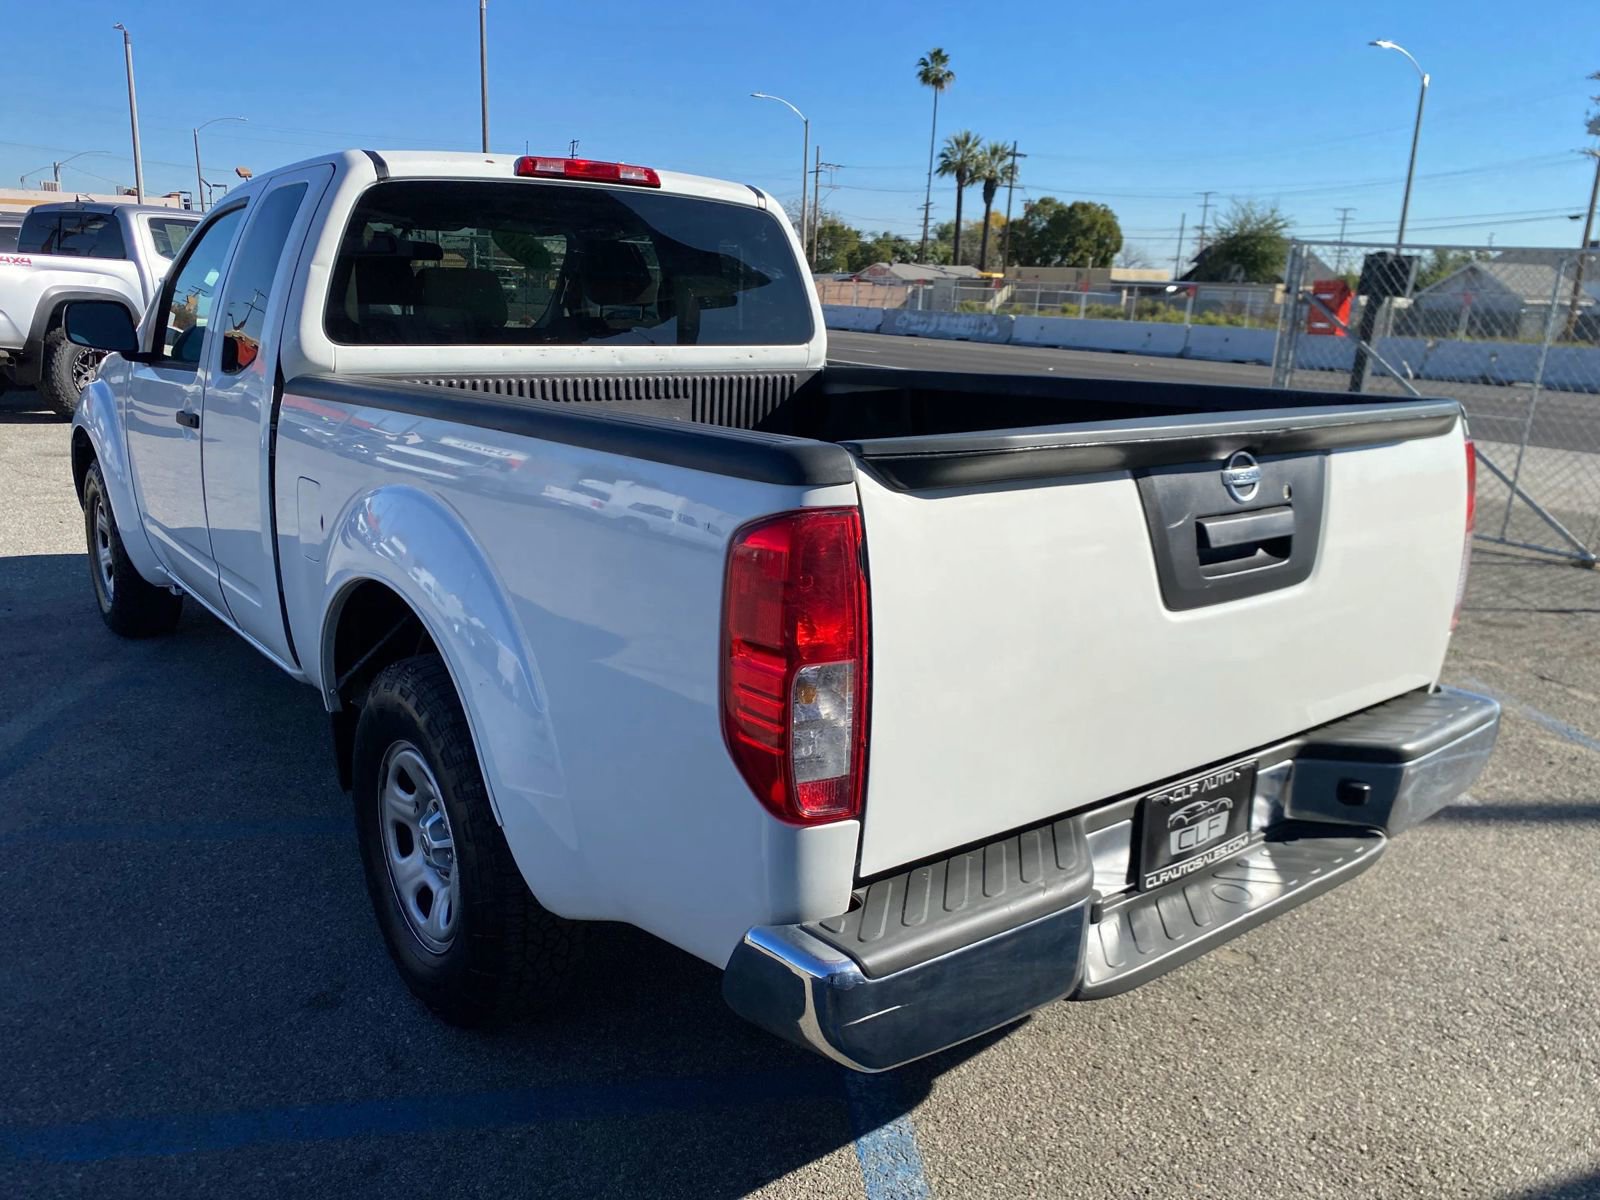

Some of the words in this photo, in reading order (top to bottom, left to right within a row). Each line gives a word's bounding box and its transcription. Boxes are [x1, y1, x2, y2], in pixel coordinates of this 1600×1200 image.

[1173, 783, 1199, 801] CLF
[1201, 770, 1234, 792] AUTO
[1178, 815, 1222, 850] CLF
[1146, 836, 1249, 888] CLFAUTOSALES.COM
